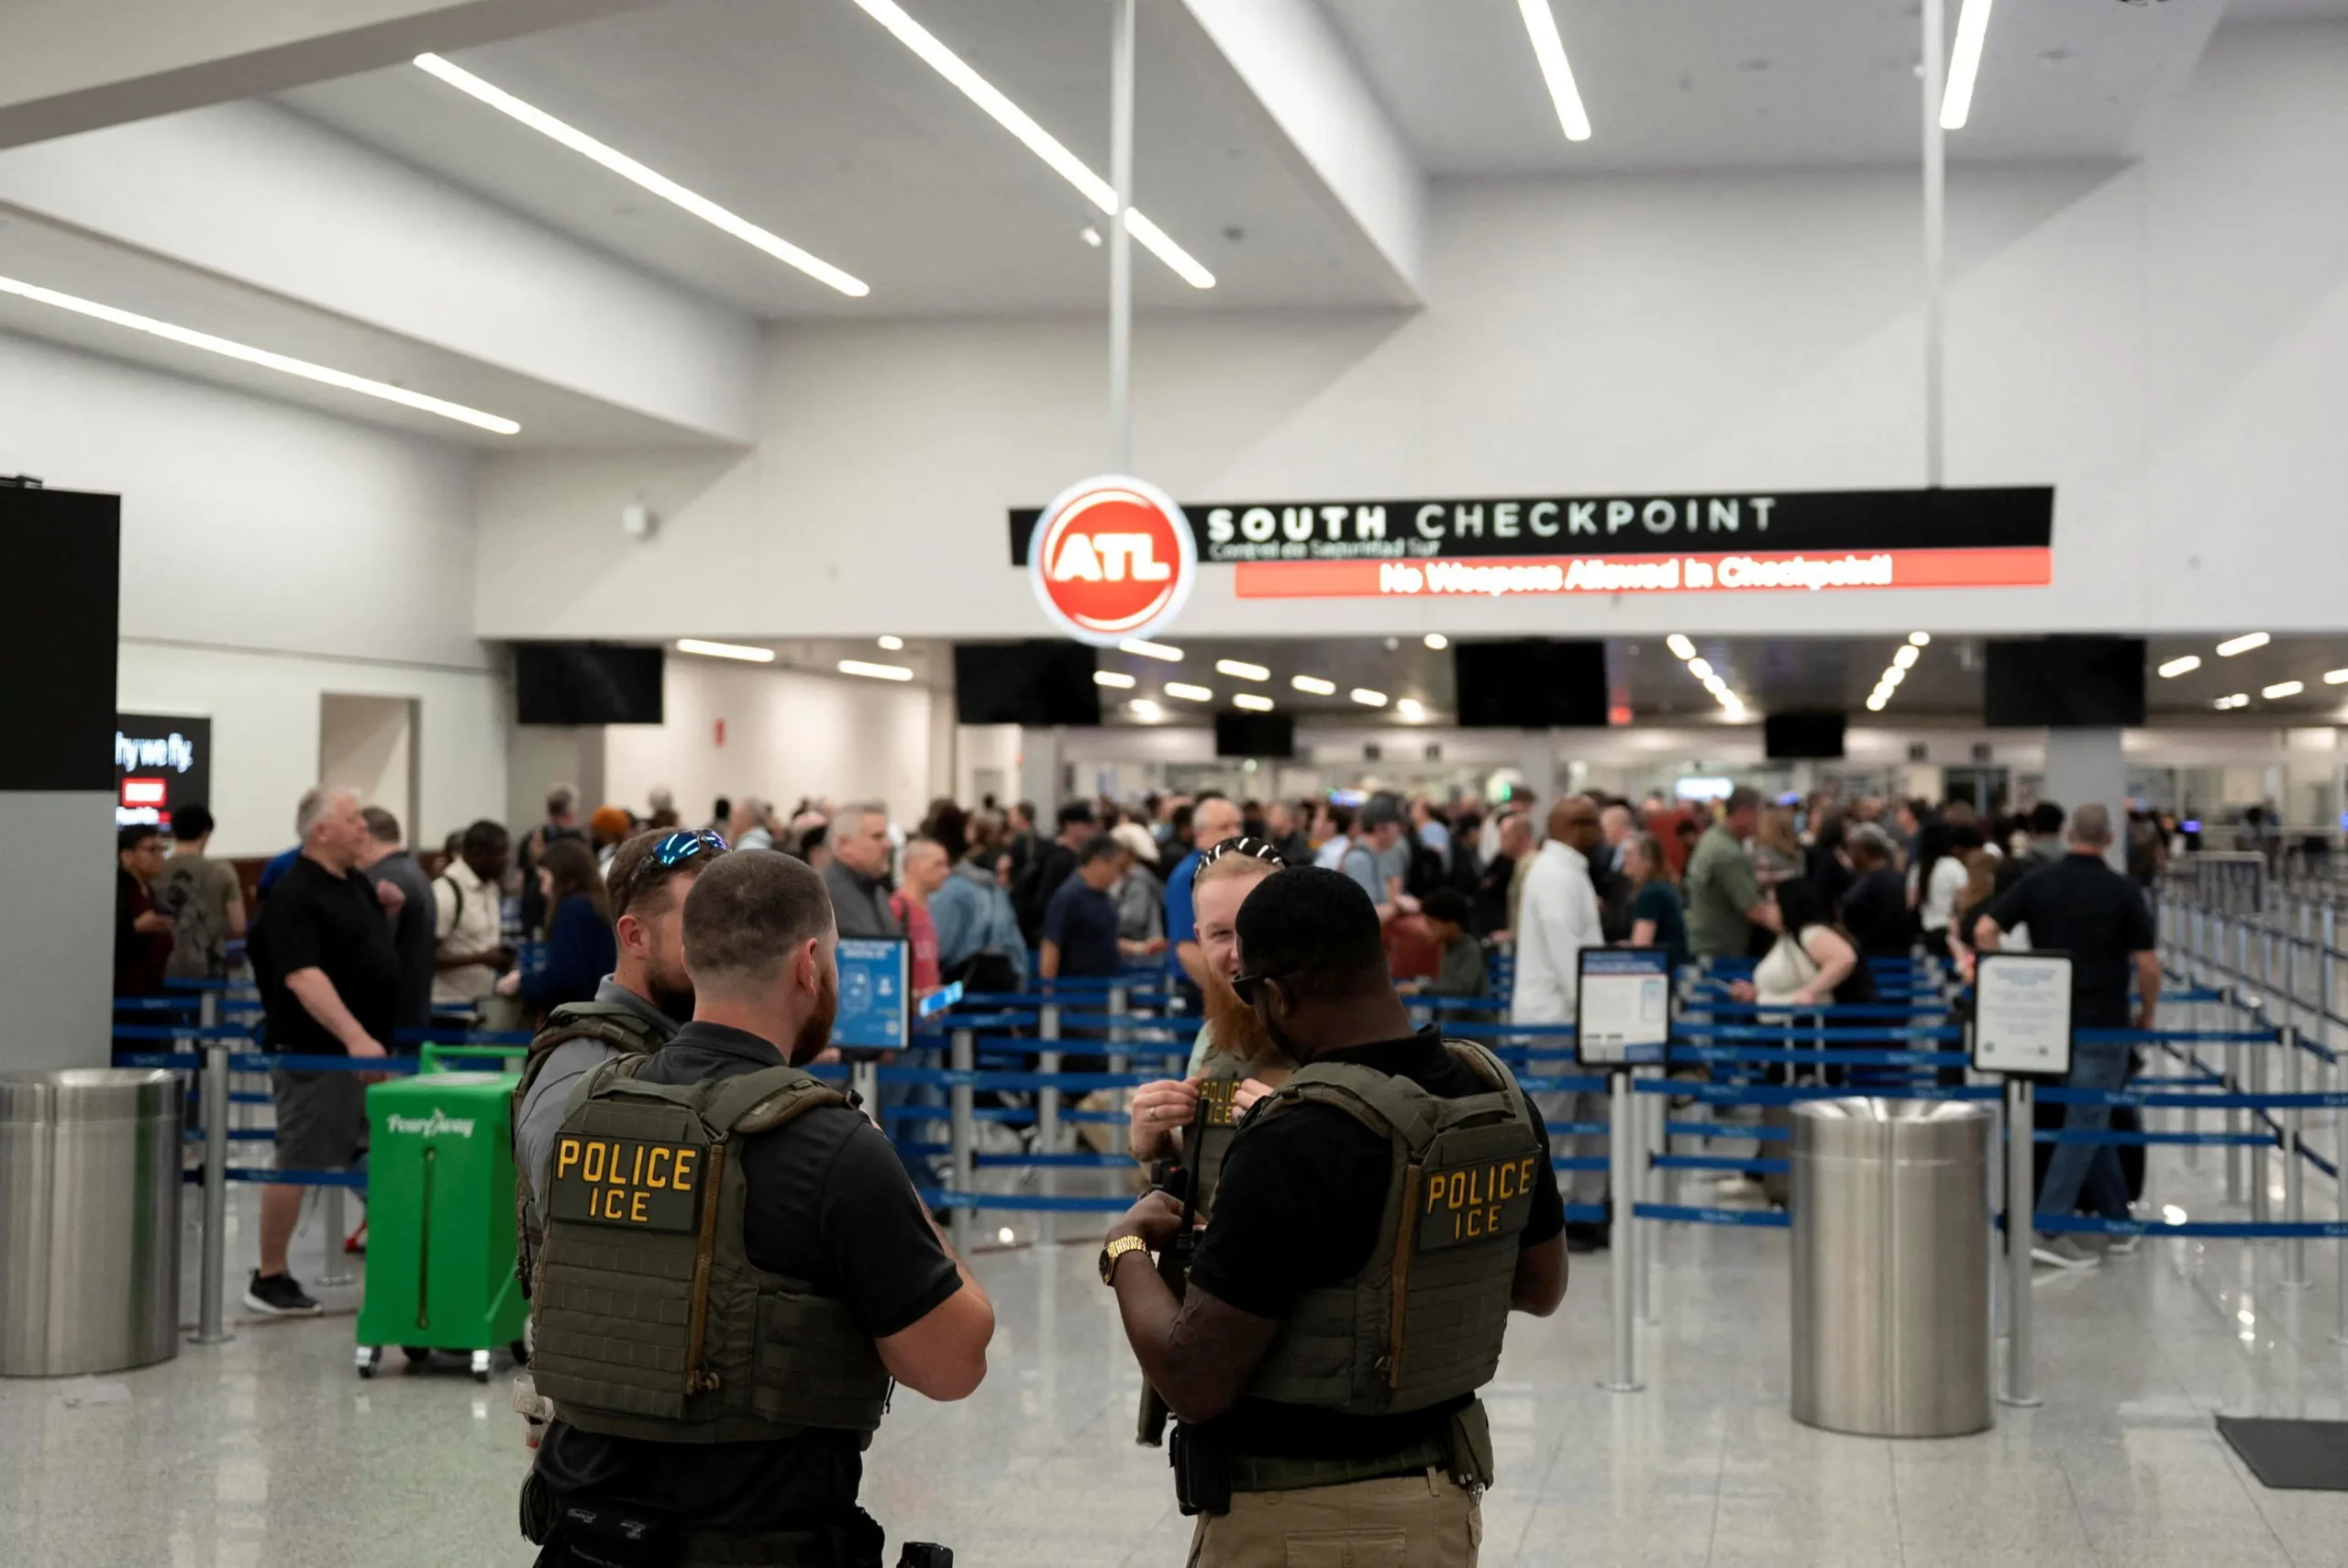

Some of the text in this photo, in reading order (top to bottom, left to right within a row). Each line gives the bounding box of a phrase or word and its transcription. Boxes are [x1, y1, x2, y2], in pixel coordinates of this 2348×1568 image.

[1207, 496, 1777, 543] SOUTH CHECKPOINT
[1054, 532, 1171, 581] ATL
[1379, 562, 1423, 594] No
[1425, 561, 1563, 597] Weapons
[1564, 558, 1679, 591] Allowed
[1201, 1081, 1241, 1103] POLIC
[558, 1139, 697, 1191] POLICE
[1427, 1158, 1535, 1214] POLICE
[590, 1187, 651, 1221] ICE
[1455, 1204, 1502, 1240] ICE
